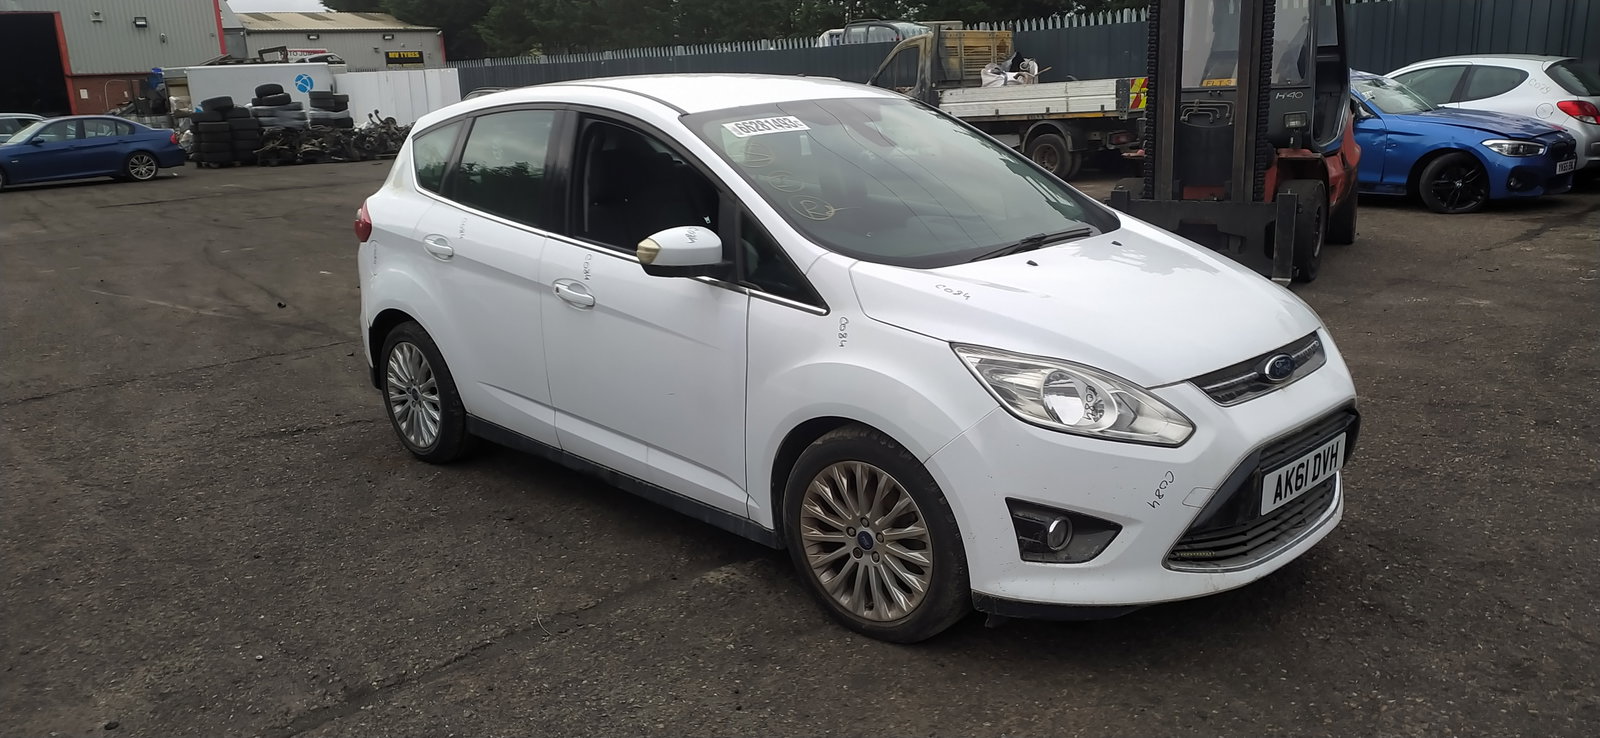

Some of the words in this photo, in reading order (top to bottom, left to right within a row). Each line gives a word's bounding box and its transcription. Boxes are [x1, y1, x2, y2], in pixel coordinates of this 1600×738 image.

[734, 117, 798, 133] 66281493
[1273, 459, 1311, 505] AK61
[1311, 441, 1340, 484] DVH
